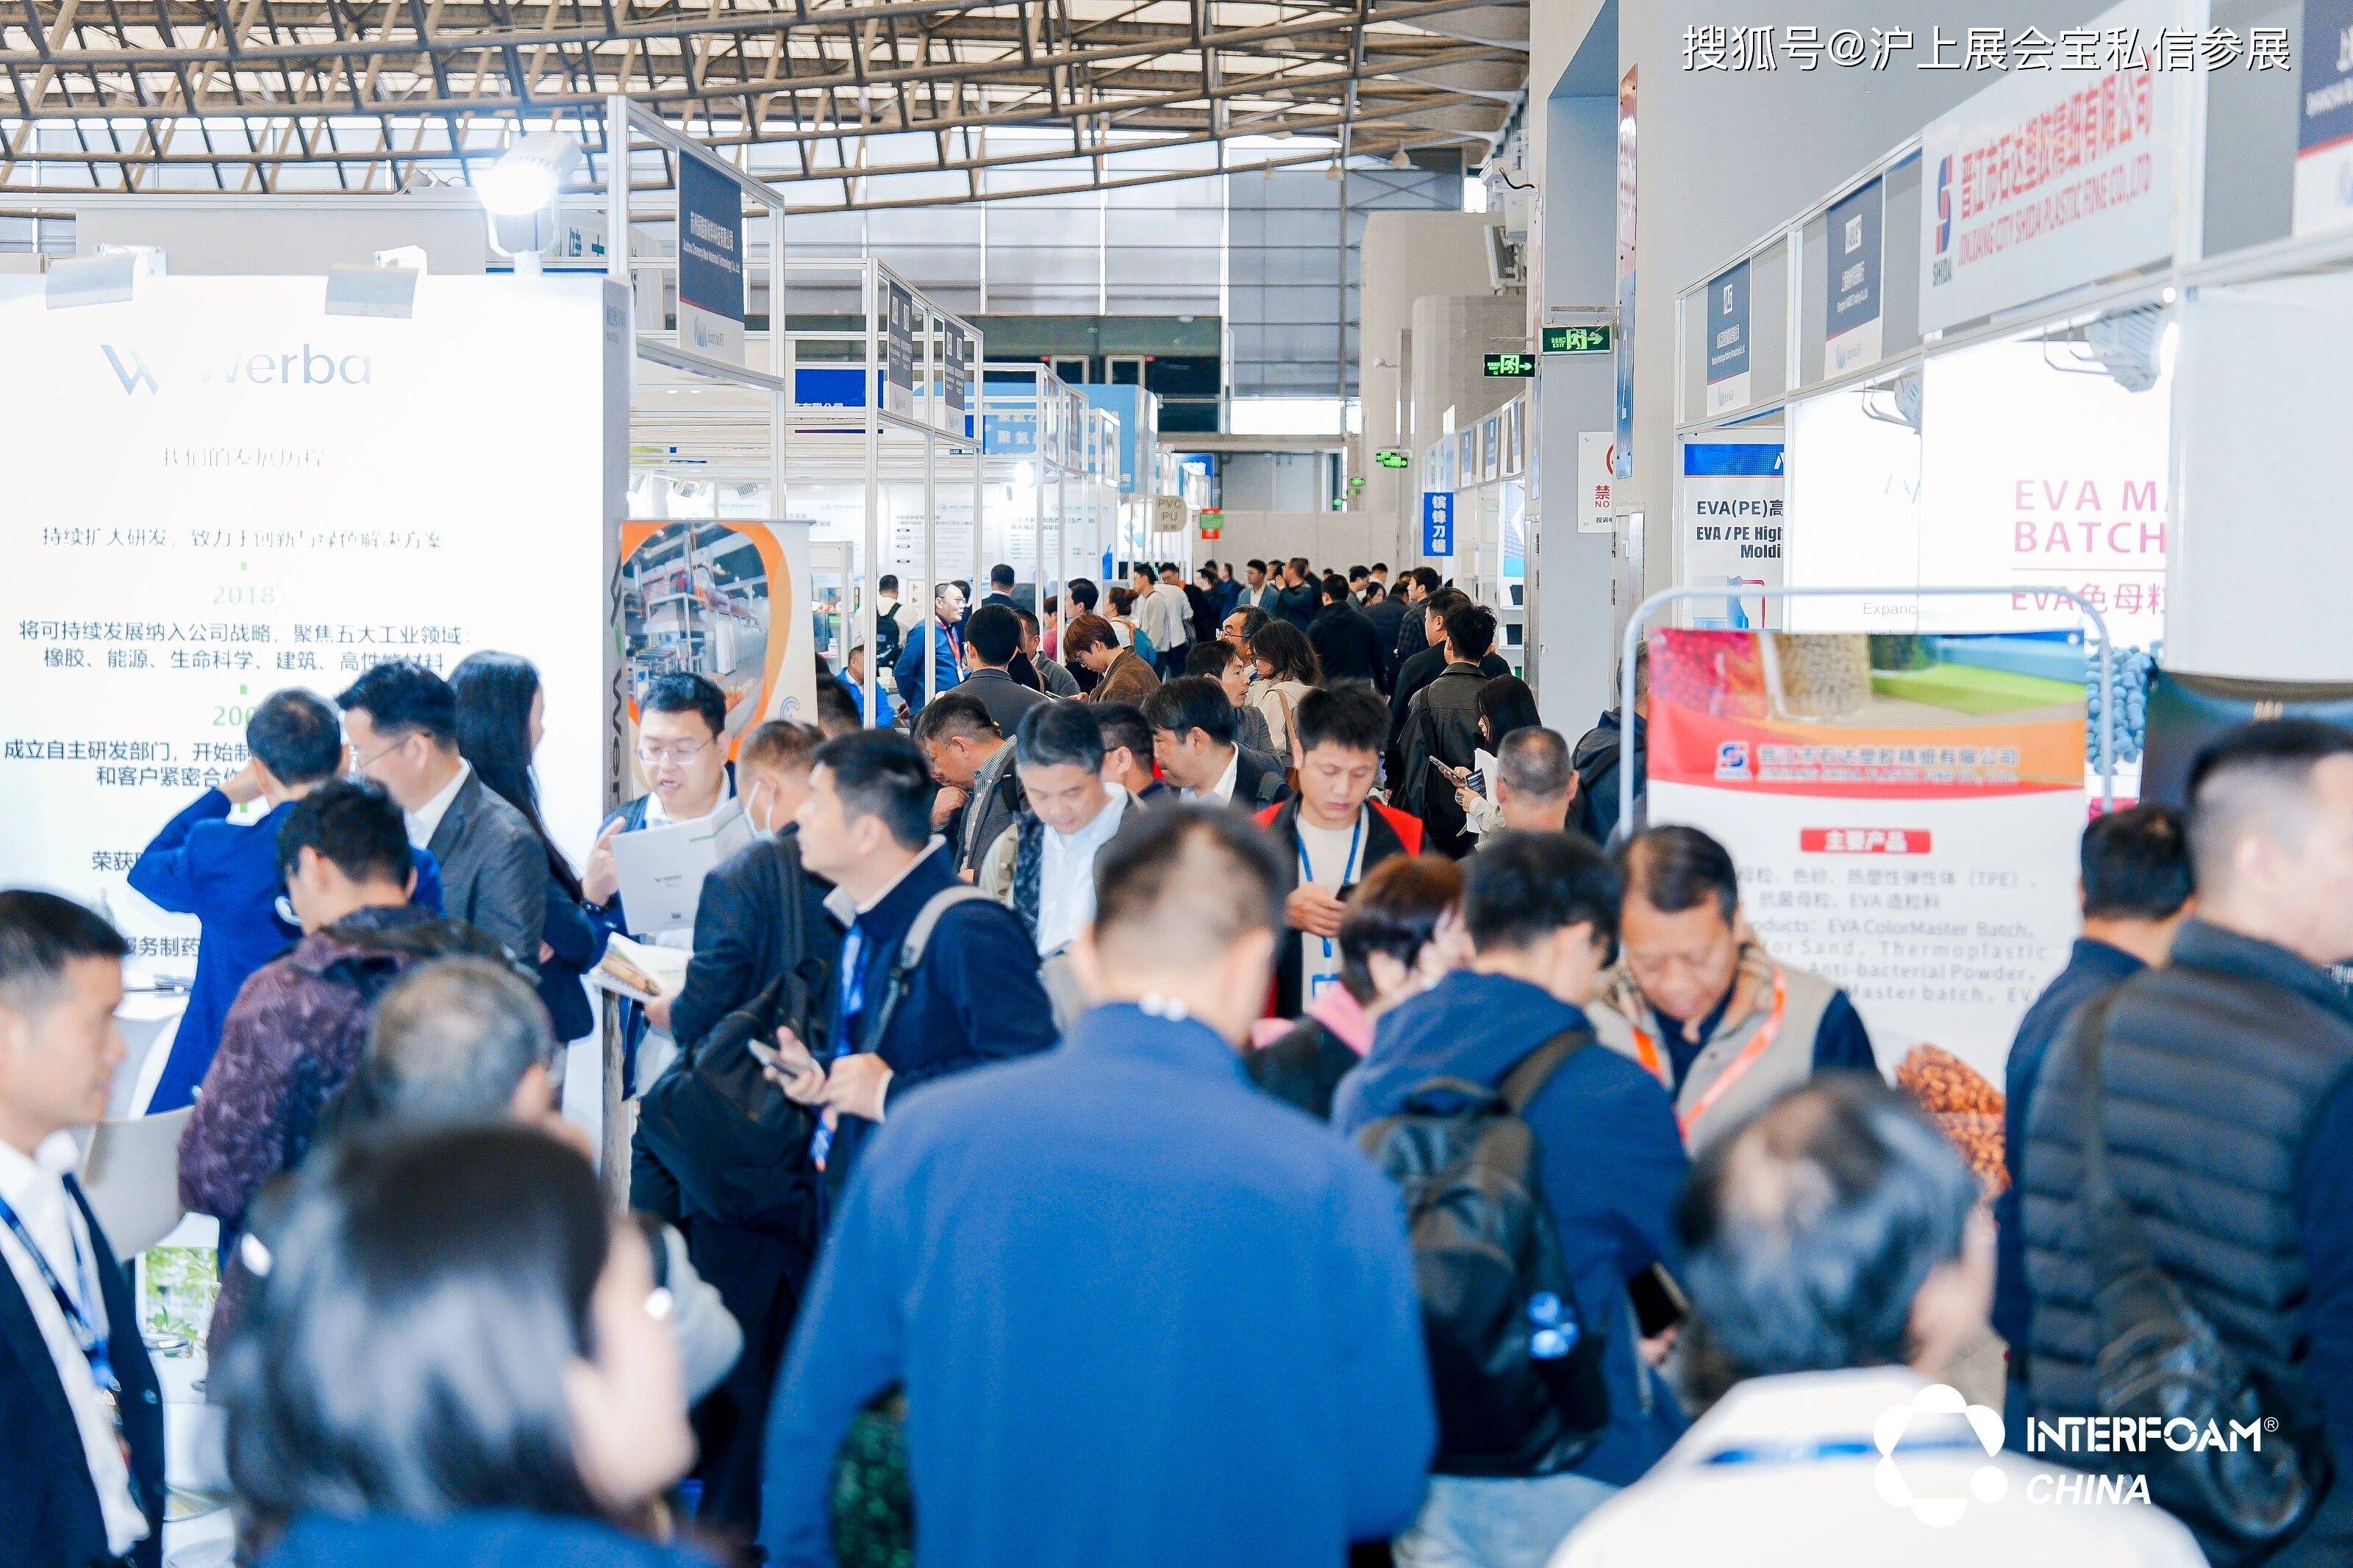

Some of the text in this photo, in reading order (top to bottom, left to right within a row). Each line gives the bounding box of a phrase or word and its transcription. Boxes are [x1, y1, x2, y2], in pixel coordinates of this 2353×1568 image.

[1158, 498, 1182, 509] PVC
[2015, 480, 2168, 512] EVA M
[1162, 512, 1178, 520] PU
[1696, 526, 1721, 540] EVA
[2014, 520, 2166, 554] BATCH
[213, 585, 275, 605] 2018
[213, 705, 257, 727] 200
[92, 850, 143, 872] 荣获
